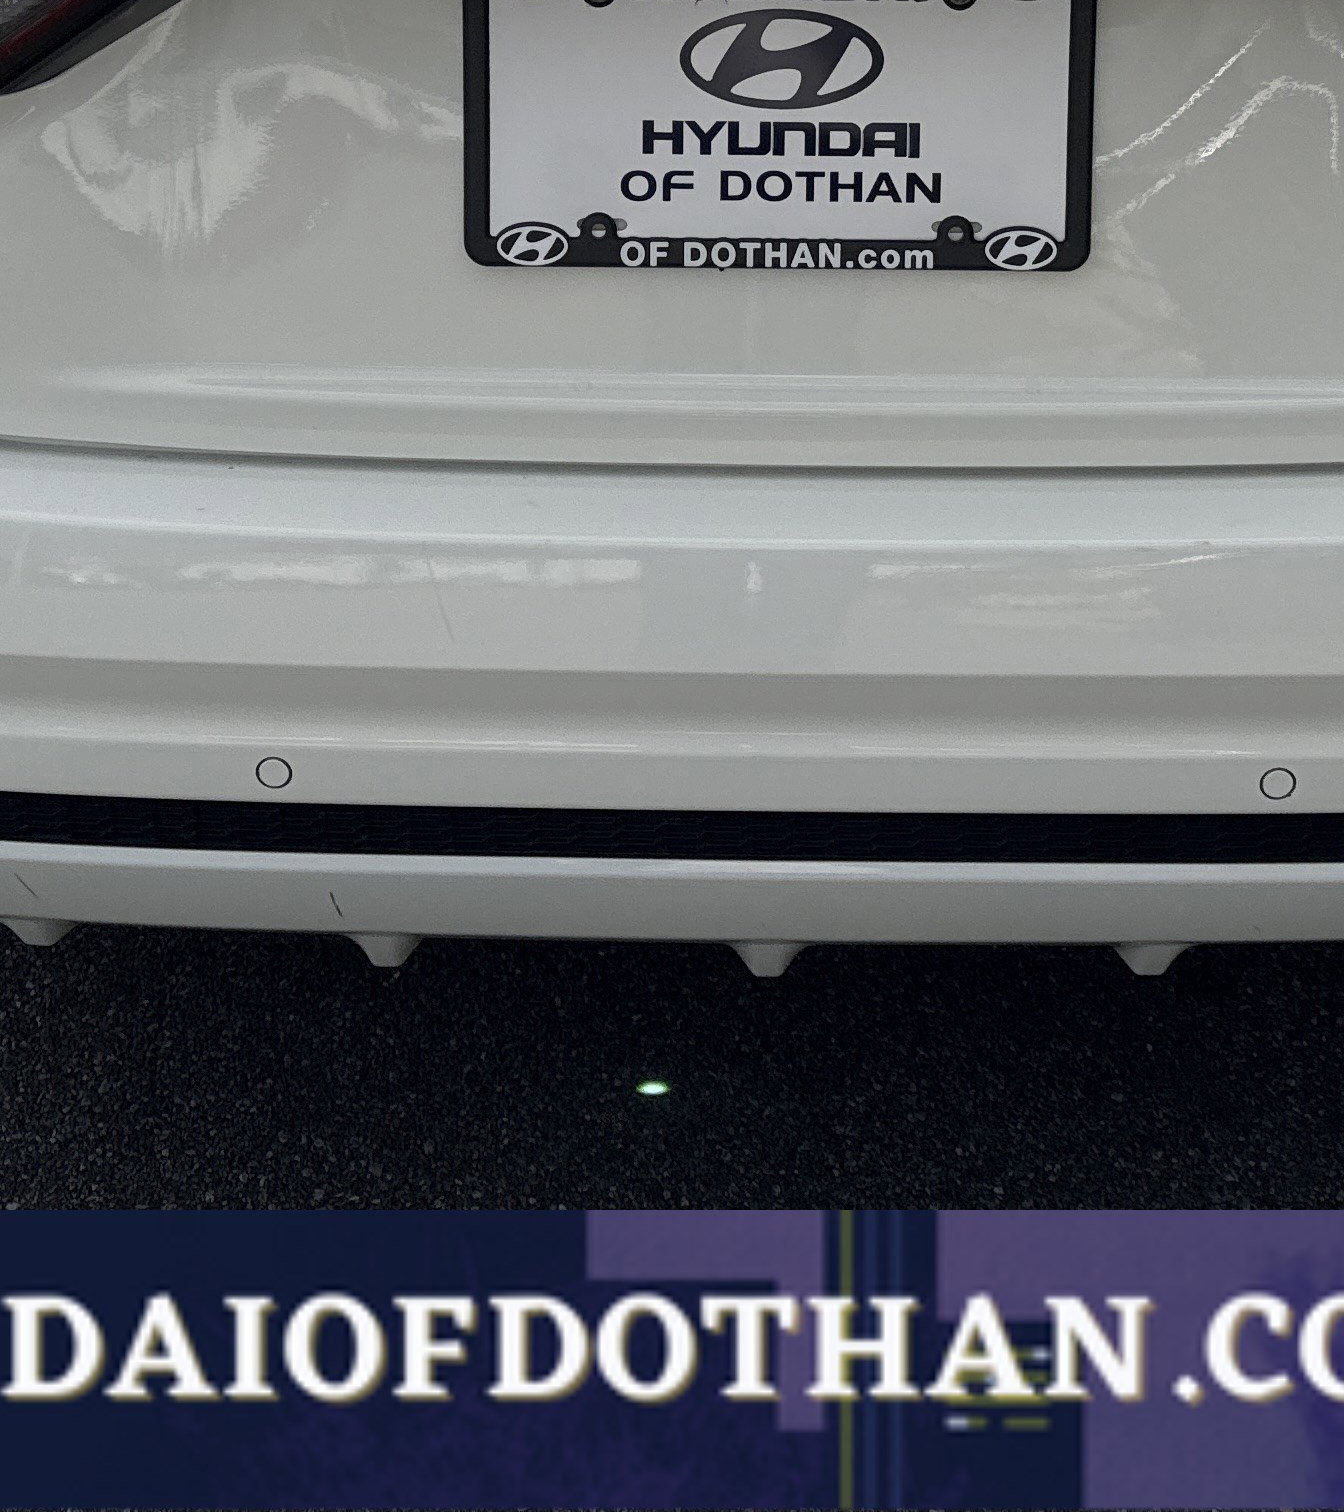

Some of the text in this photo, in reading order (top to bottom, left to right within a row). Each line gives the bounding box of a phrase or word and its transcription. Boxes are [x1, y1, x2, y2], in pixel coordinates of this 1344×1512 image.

[642, 120, 921, 158] HYUNDAI
[620, 170, 942, 204] OF DOTHAN
[620, 241, 934, 270] OF DOTHAN.com
